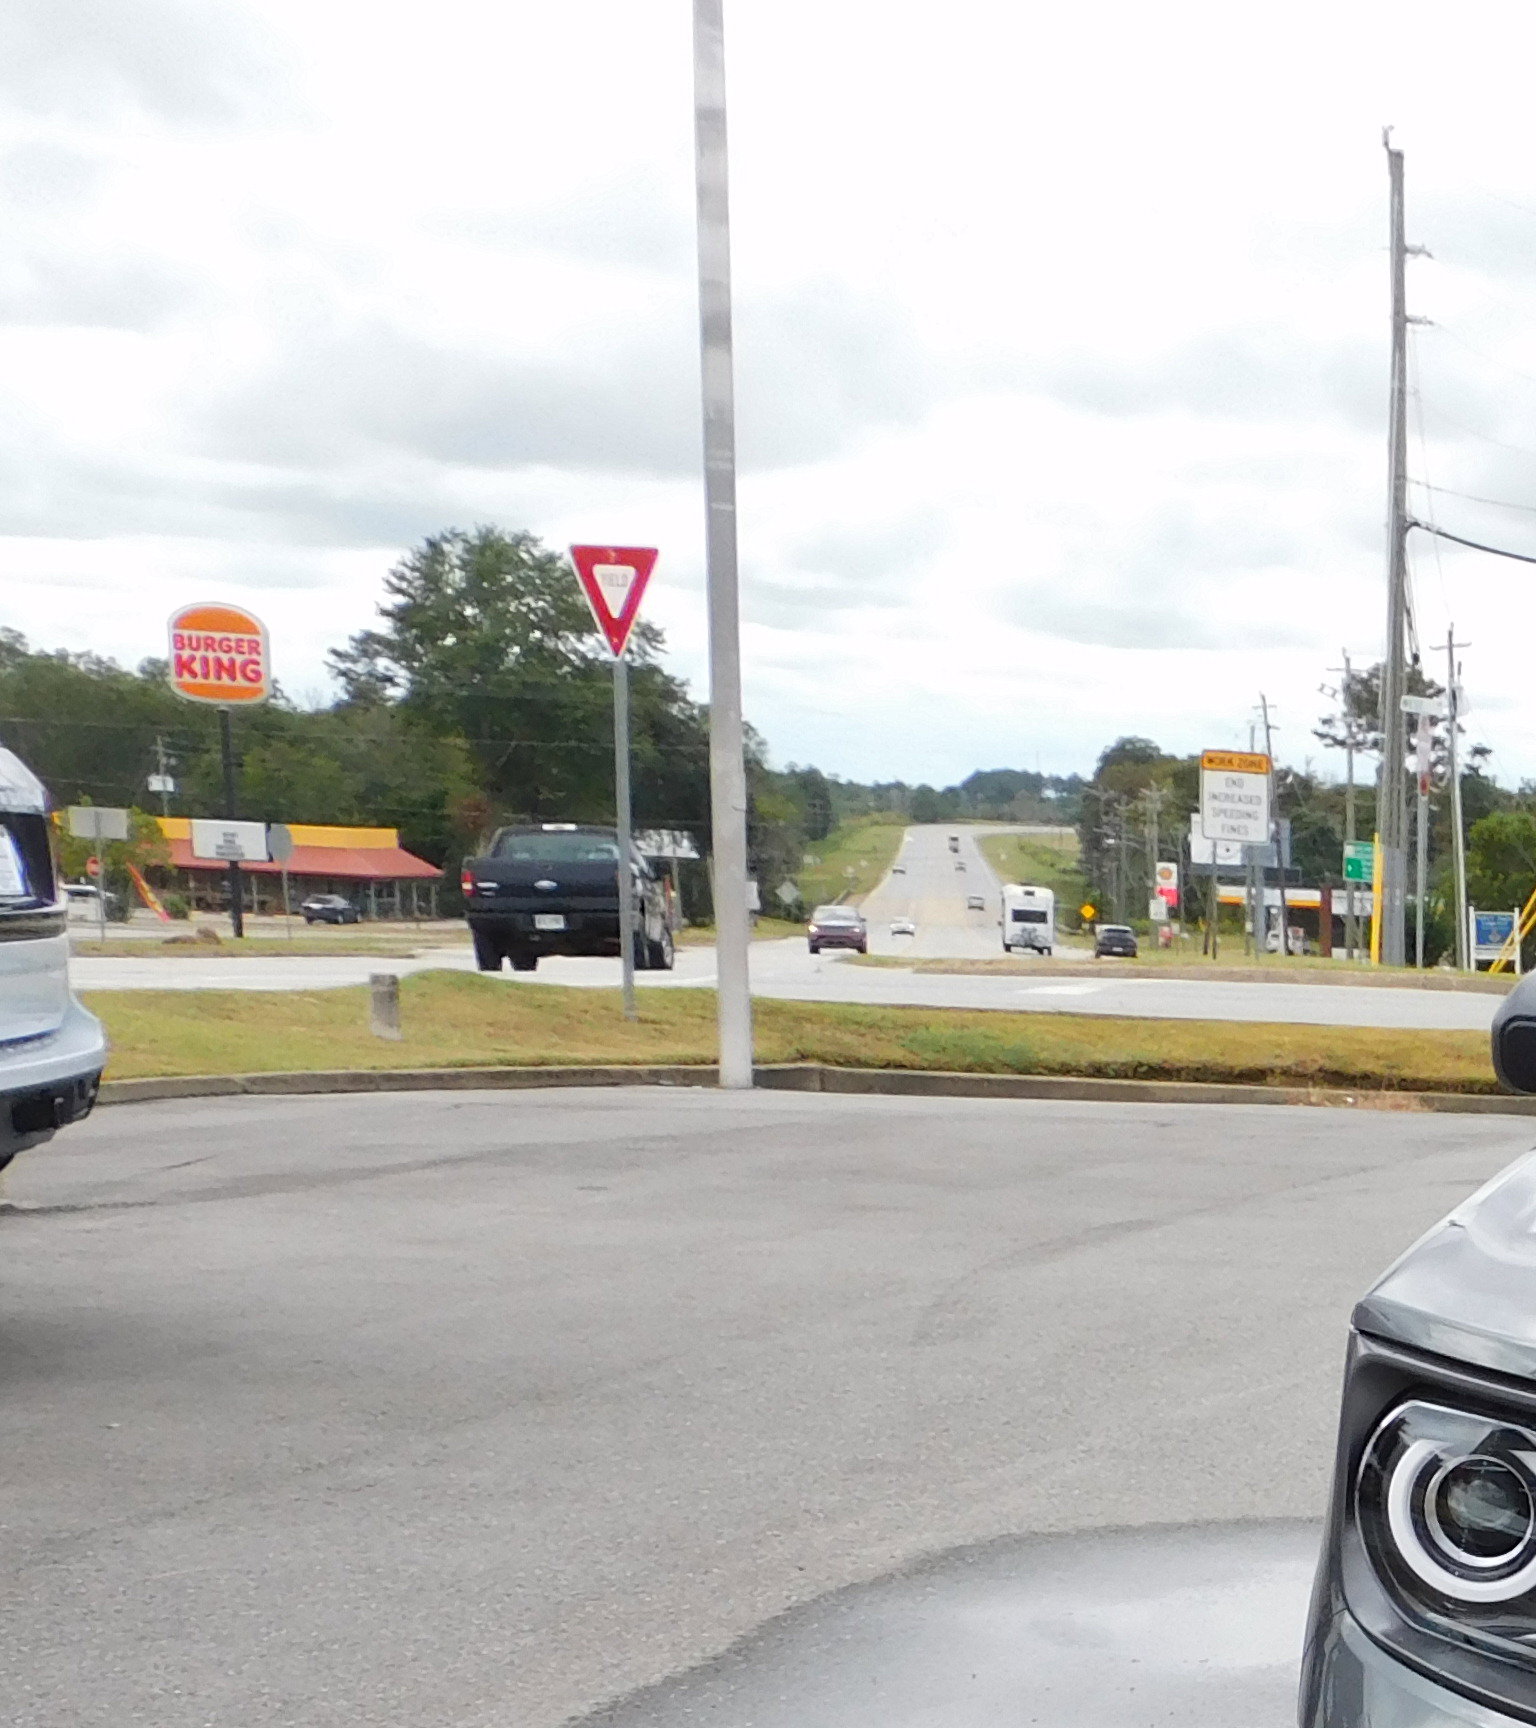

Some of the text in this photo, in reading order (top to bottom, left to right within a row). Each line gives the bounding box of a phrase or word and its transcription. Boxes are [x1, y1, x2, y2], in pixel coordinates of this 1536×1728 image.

[173, 633, 261, 656] BURGER
[174, 653, 263, 683] KING
[1206, 756, 1264, 771] WORK ZONE
[1224, 776, 1245, 789] END
[1207, 791, 1262, 806] INCREASED
[1210, 807, 1259, 821] SPEEDING
[1220, 823, 1249, 836] FINES
